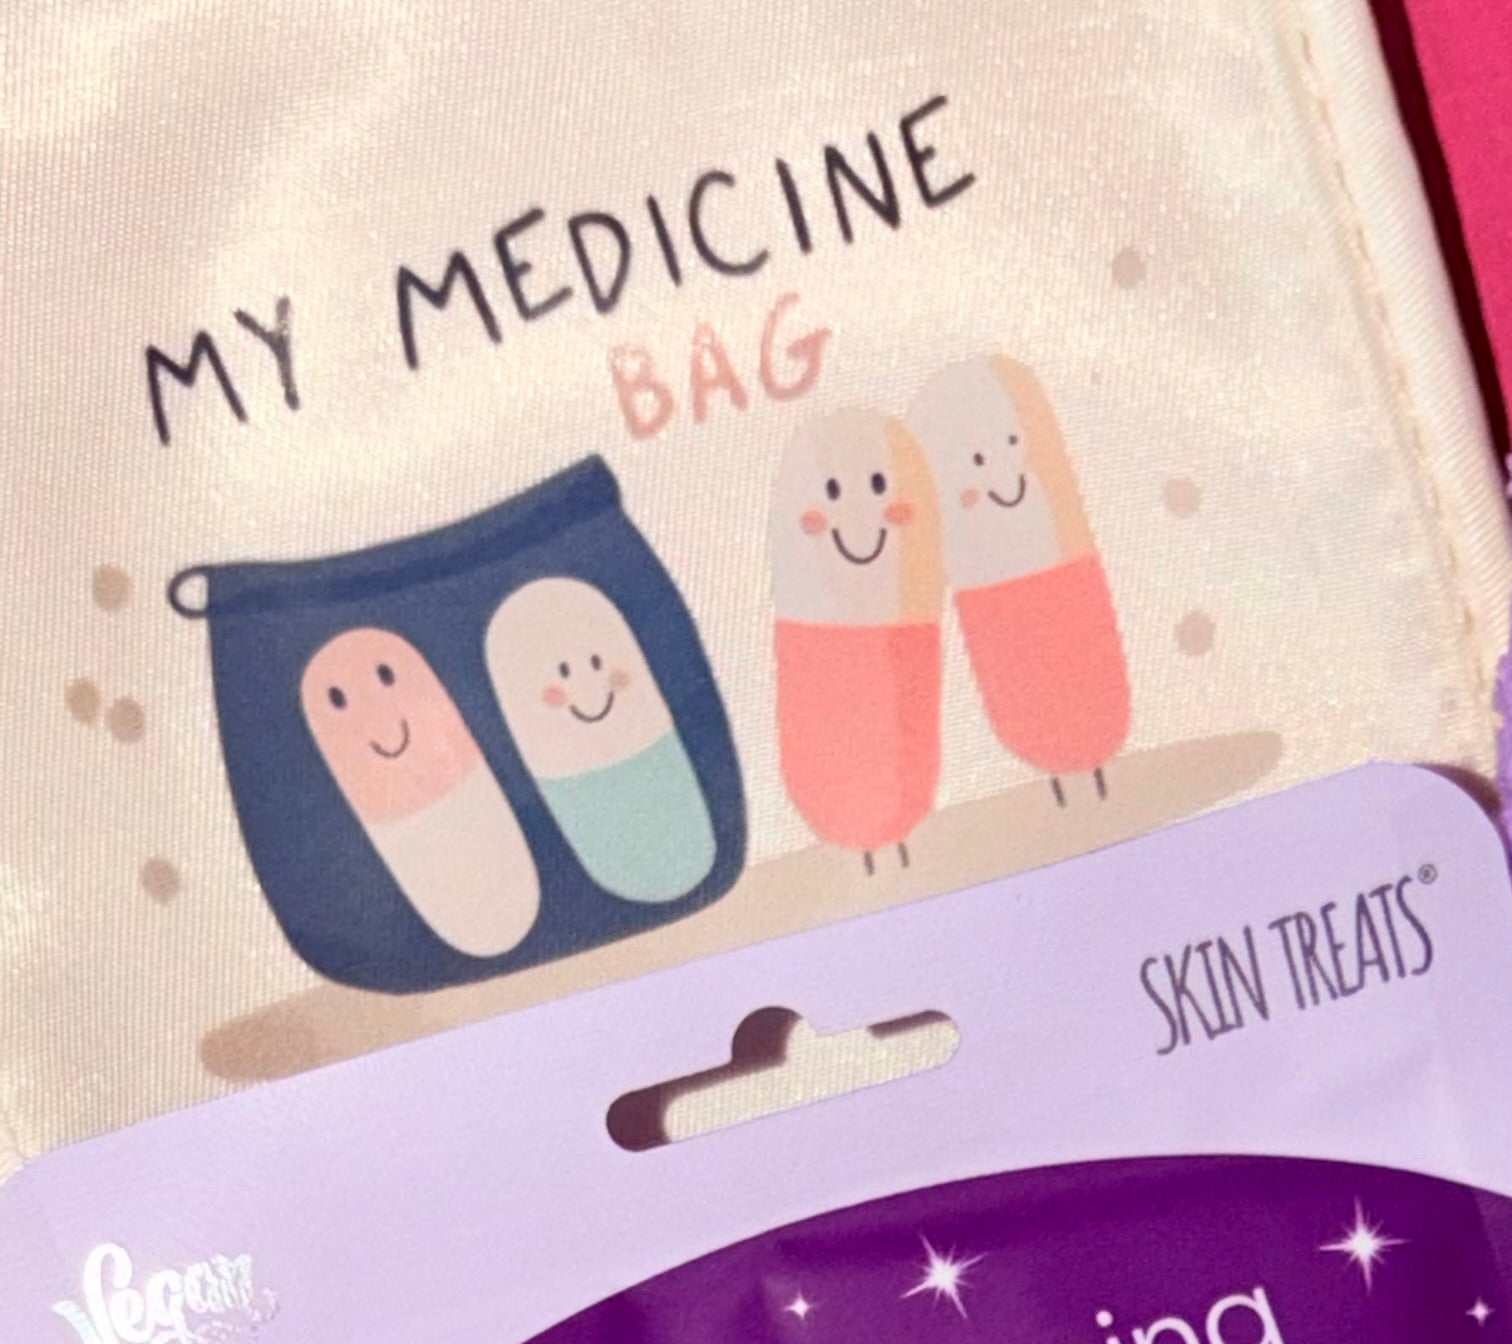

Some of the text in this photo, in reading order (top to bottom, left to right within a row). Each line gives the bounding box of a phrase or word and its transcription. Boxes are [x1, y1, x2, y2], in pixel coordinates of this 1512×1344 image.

[145, 95, 976, 446] MY MEDICINE
[608, 293, 832, 440] BAG
[1140, 925, 1269, 1055] SKIN
